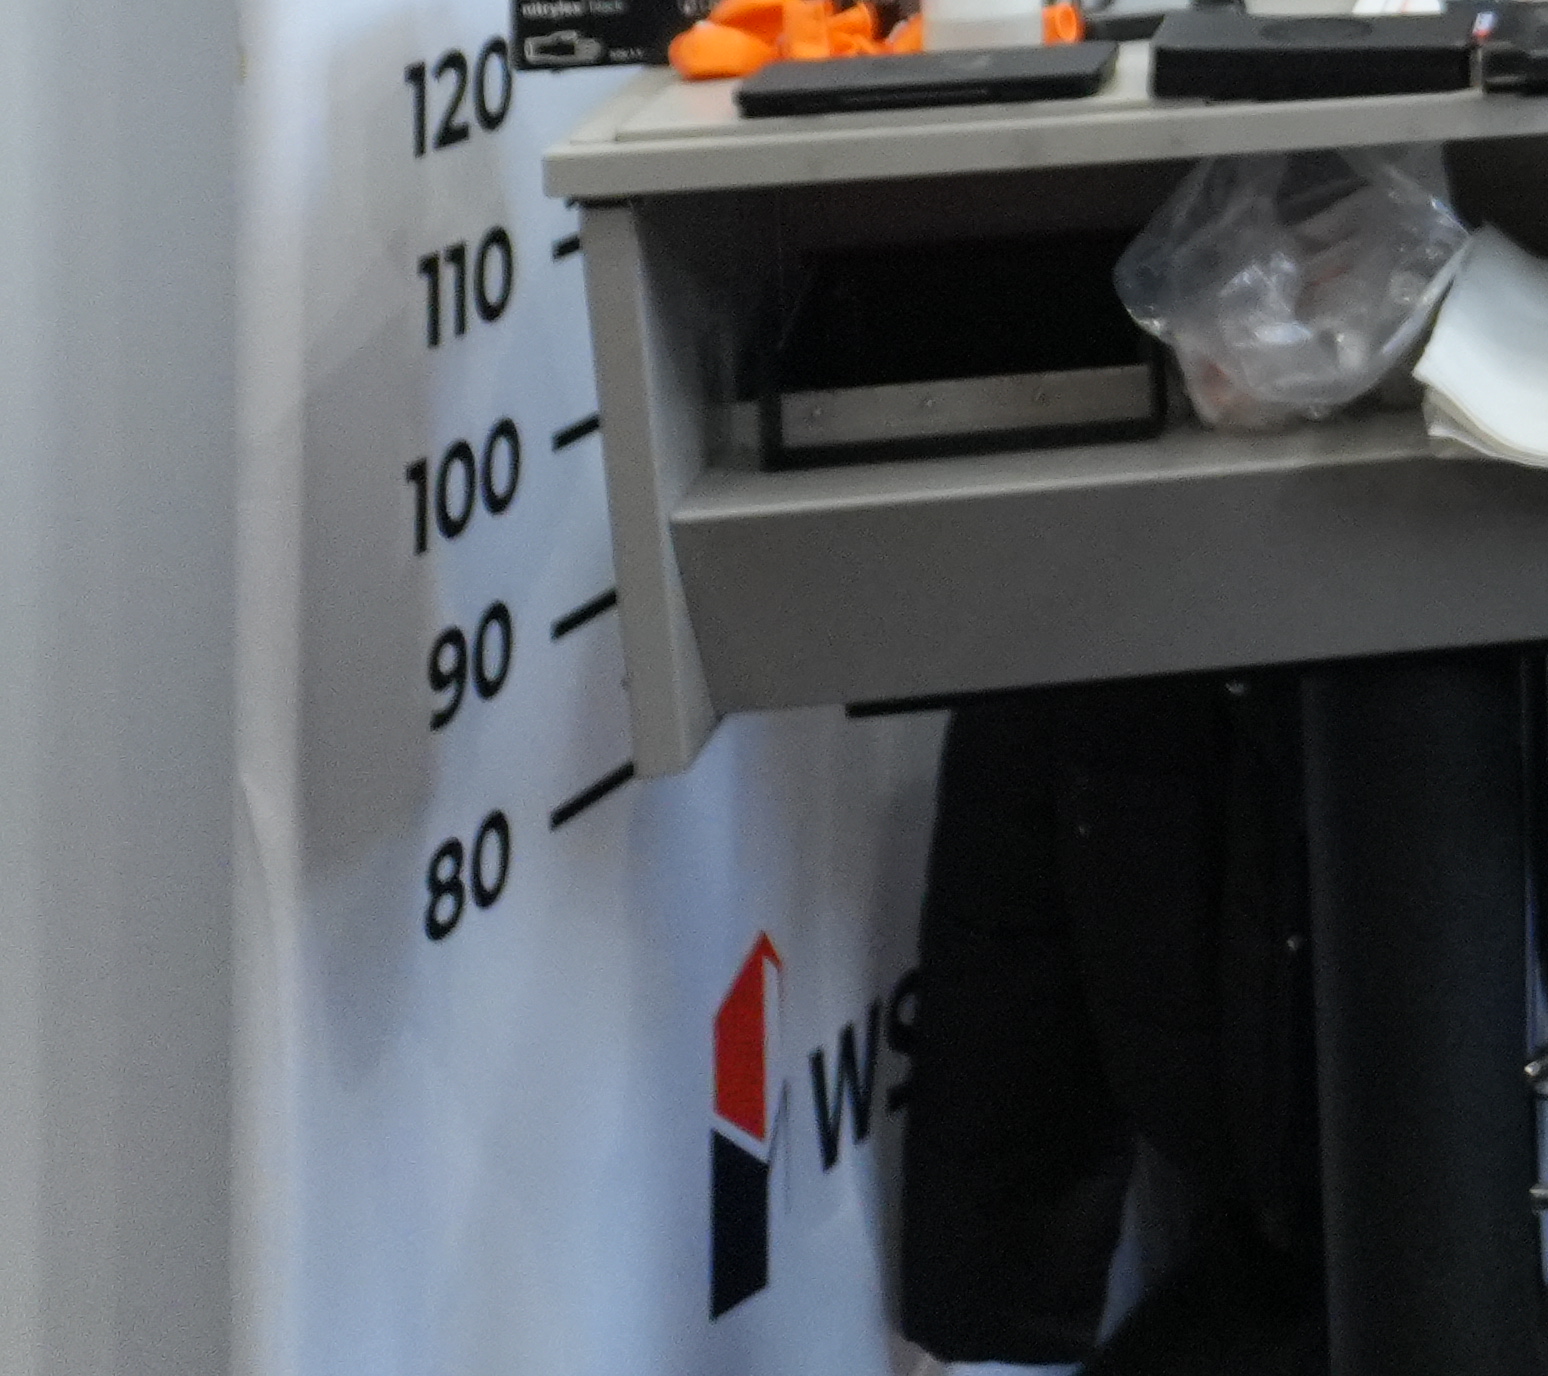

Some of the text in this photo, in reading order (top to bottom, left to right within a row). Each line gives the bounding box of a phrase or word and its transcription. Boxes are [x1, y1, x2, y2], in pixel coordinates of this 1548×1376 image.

[403, 35, 514, 160] 120
[416, 224, 515, 351] 110
[404, 416, 522, 556] 100
[425, 599, 515, 734] 90
[423, 808, 513, 943] 80
